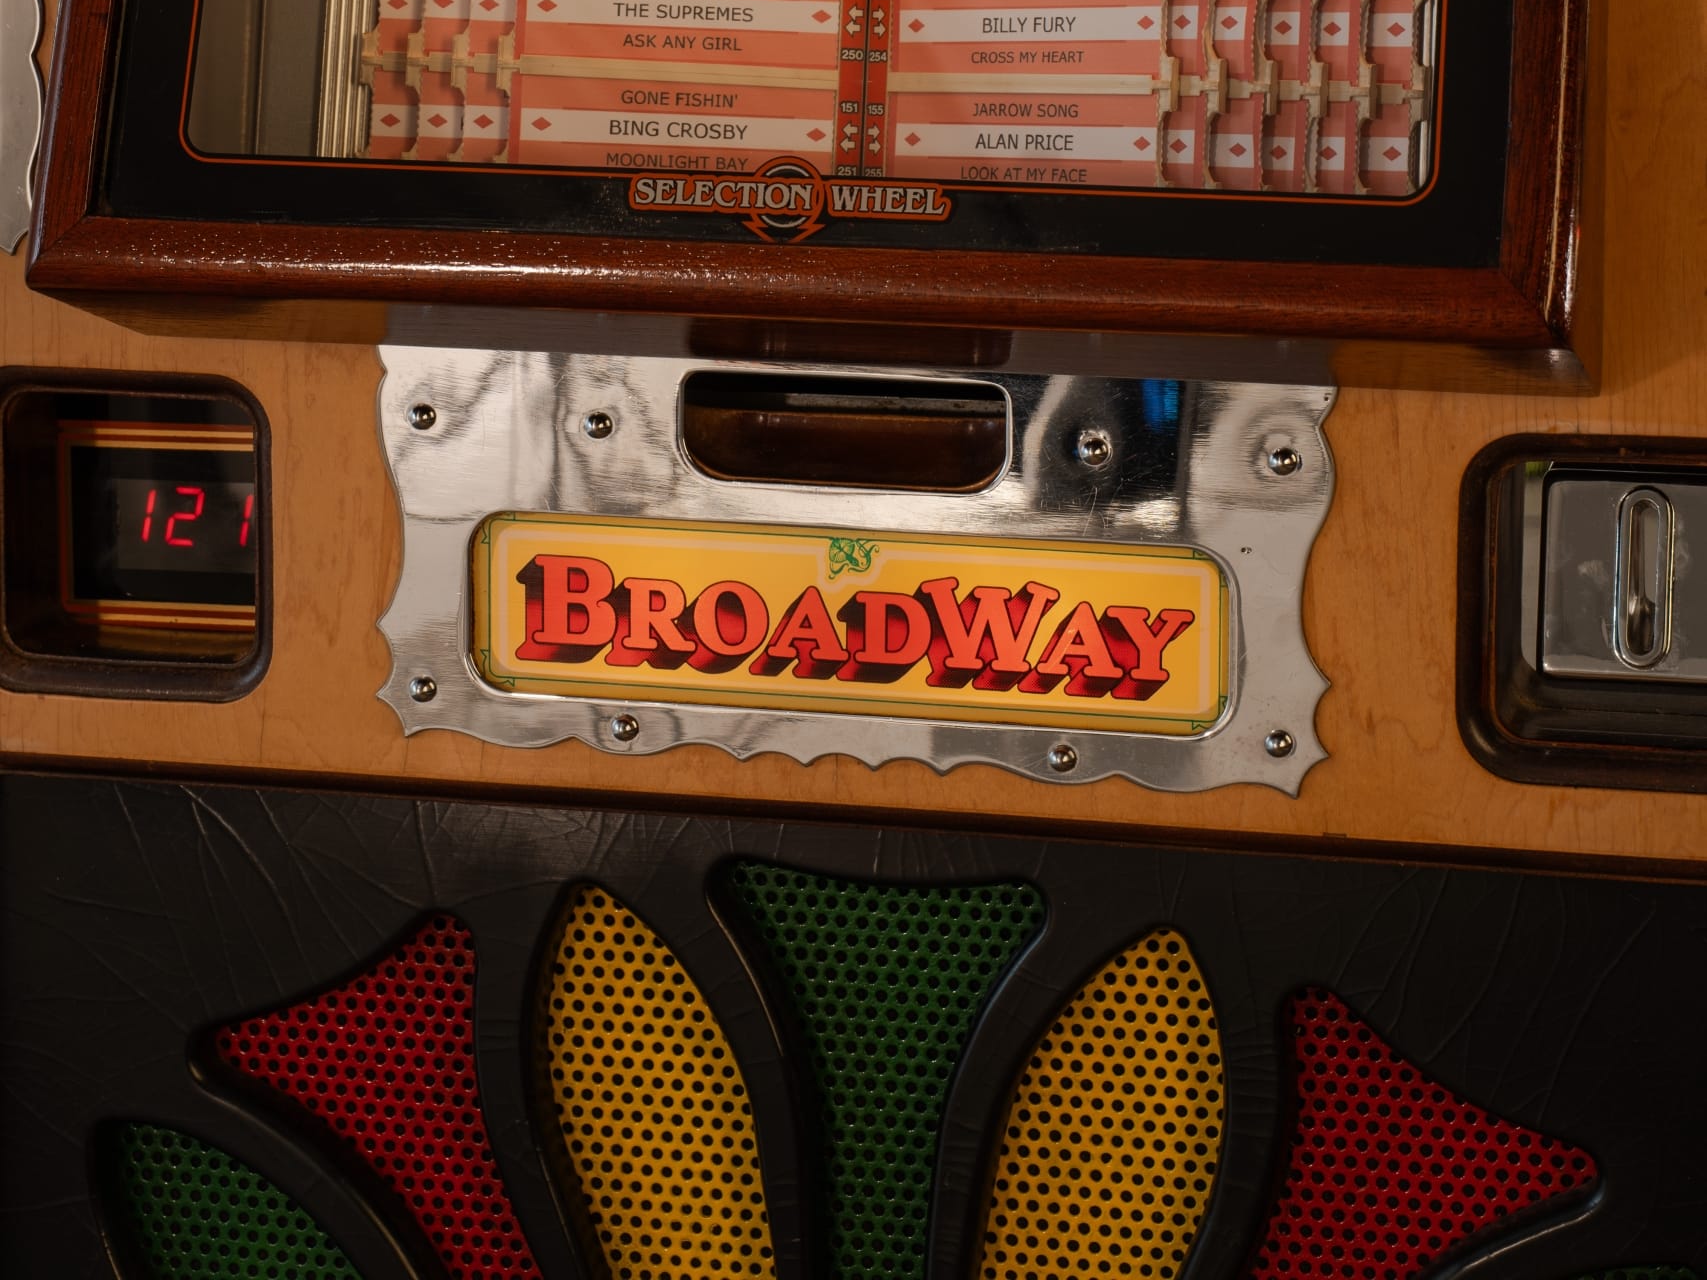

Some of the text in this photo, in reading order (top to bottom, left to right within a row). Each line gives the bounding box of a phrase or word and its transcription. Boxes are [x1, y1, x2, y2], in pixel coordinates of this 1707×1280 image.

[612, 2, 754, 23] THE SUPREMES
[982, 16, 1077, 34] BILLY FURY
[622, 33, 743, 52] ASK ANY GIRL
[841, 50, 864, 60] 250
[869, 51, 887, 62] 254
[970, 50, 1085, 65] CROSS MY HEART
[620, 89, 739, 109] GONE FISHIN'
[841, 102, 859, 113] 151
[868, 105, 883, 115] 155
[972, 102, 1080, 119] JARROW SONG
[609, 119, 748, 141] BING CROSBY
[974, 132, 1075, 152] ALAN PRICE
[606, 152, 749, 171] MOONLIGHT BAY
[837, 166, 857, 177] 251
[959, 166, 1088, 183] LOOK AT MY FACE
[634, 178, 947, 216] SELECTION WHEEL
[517, 554, 1195, 699] BROADWAY
